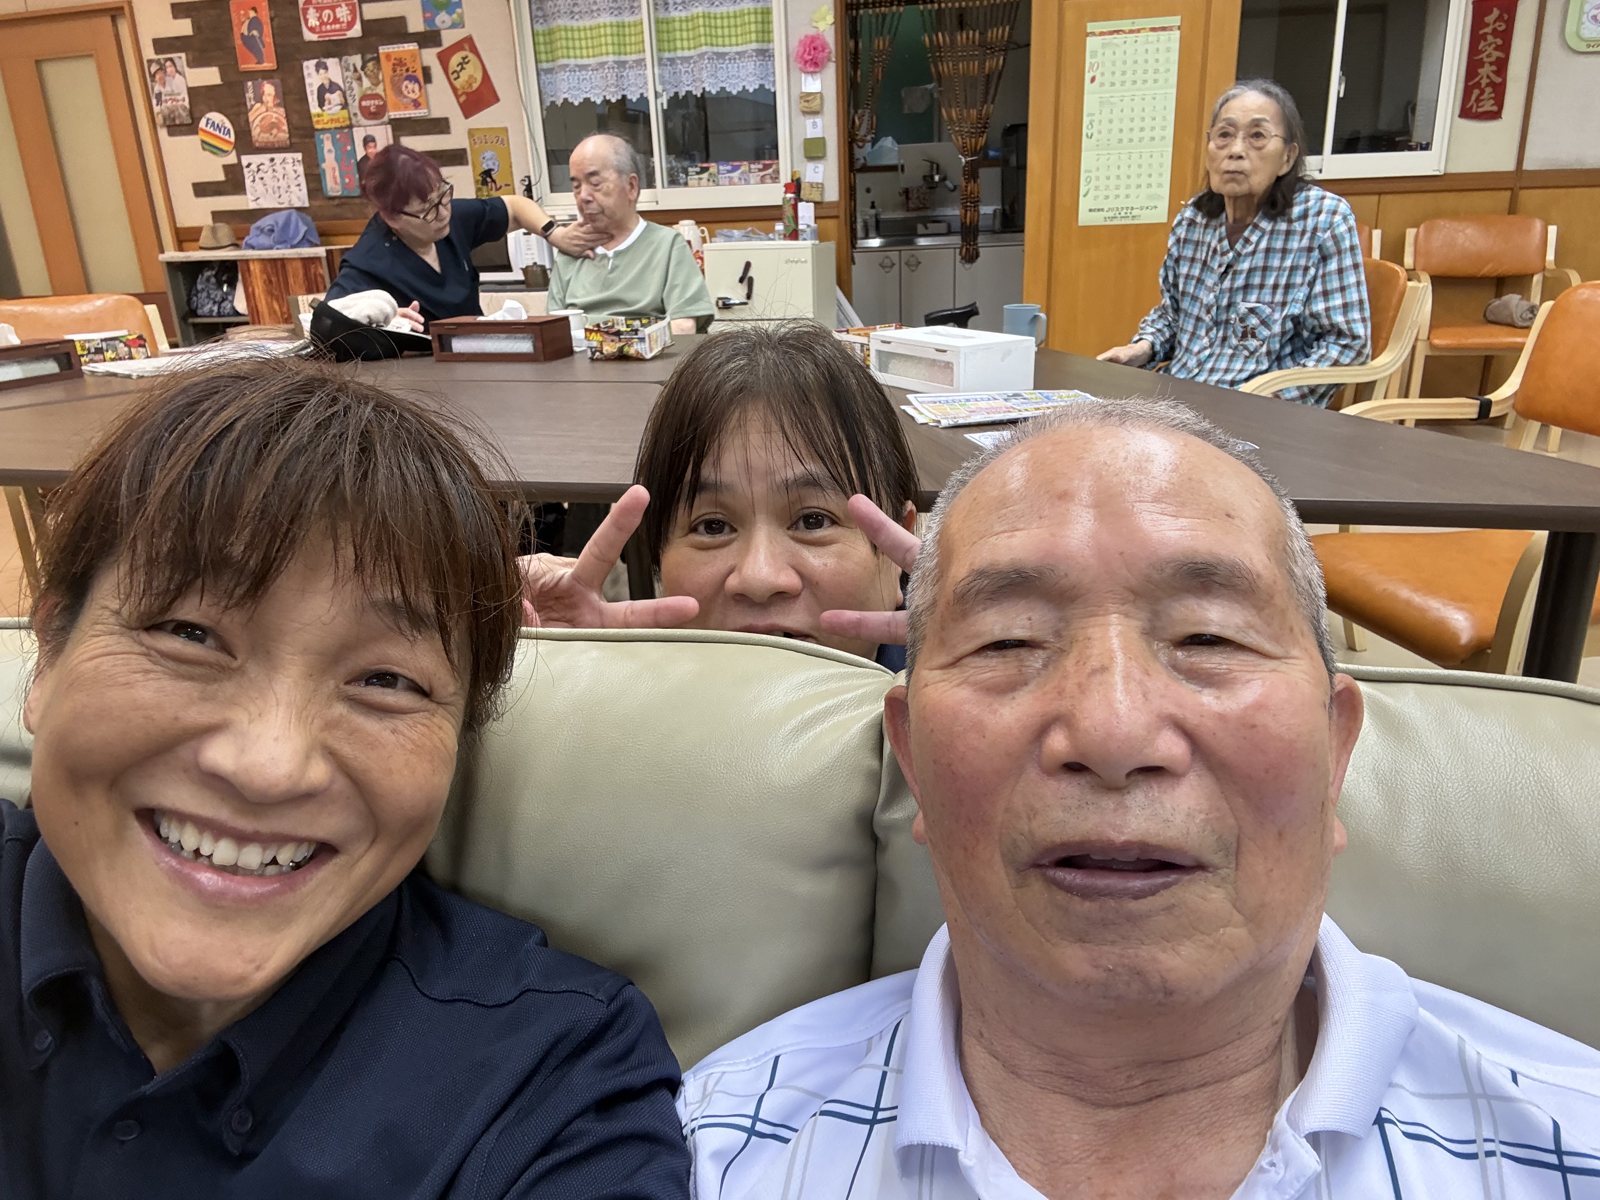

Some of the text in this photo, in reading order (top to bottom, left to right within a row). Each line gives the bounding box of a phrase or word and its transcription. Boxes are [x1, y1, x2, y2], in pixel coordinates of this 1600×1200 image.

[205, 117, 231, 139] FANTA
[812, 121, 818, 129] B
[813, 166, 819, 174] C
